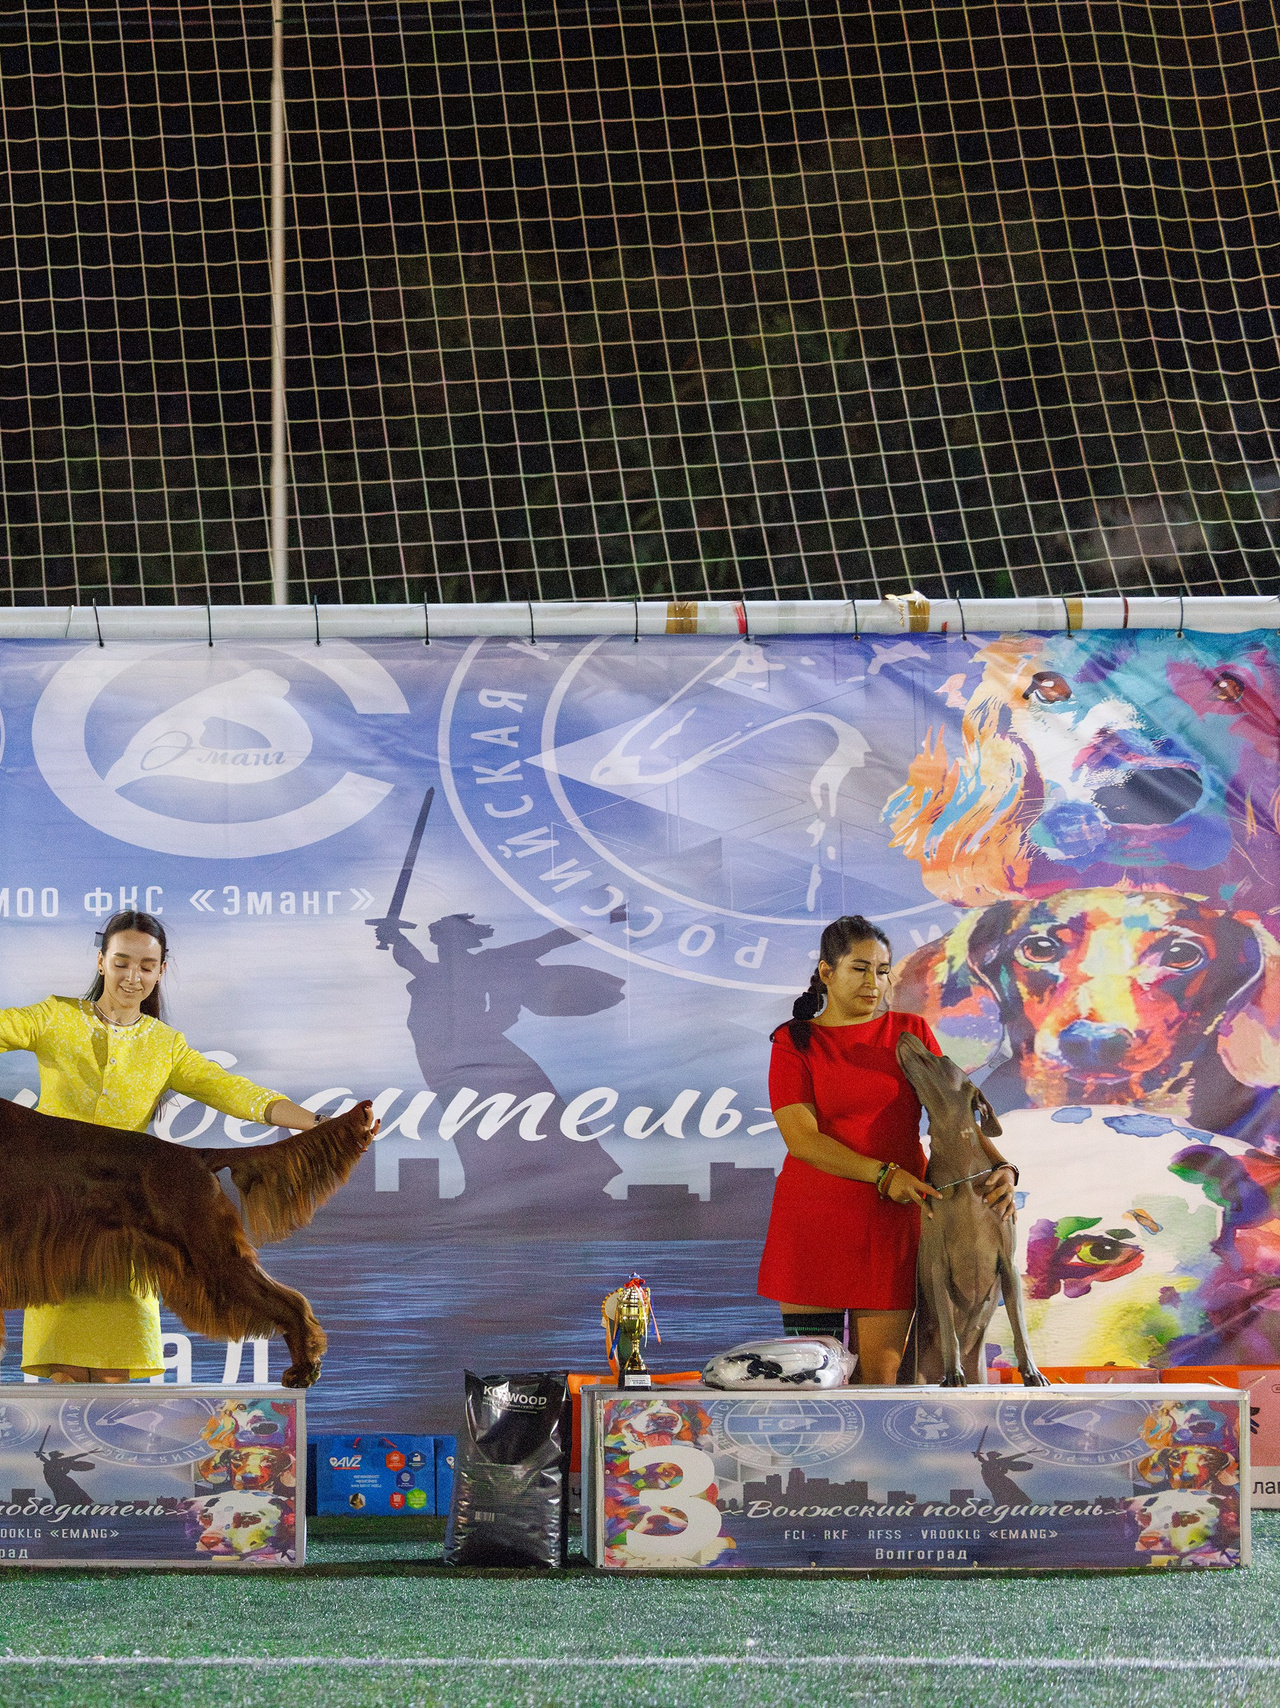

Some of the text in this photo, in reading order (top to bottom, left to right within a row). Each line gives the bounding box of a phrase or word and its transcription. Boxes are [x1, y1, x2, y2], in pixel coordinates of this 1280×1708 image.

[471, 688, 769, 969] РОССИЙСКАЯ
[189, 885, 375, 915] «Эманг»
[626, 1445, 722, 1558] 3
[720, 1497, 1127, 1524] «Волжский победитель»
[50, 1528, 119, 1539] «EMANG»
[784, 1529, 805, 1540] FCI
[824, 1529, 848, 1540] RKF
[868, 1529, 902, 1540] RFSS
[988, 1529, 1058, 1540] «EMANG»
[875, 1548, 967, 1562] Волгоград
